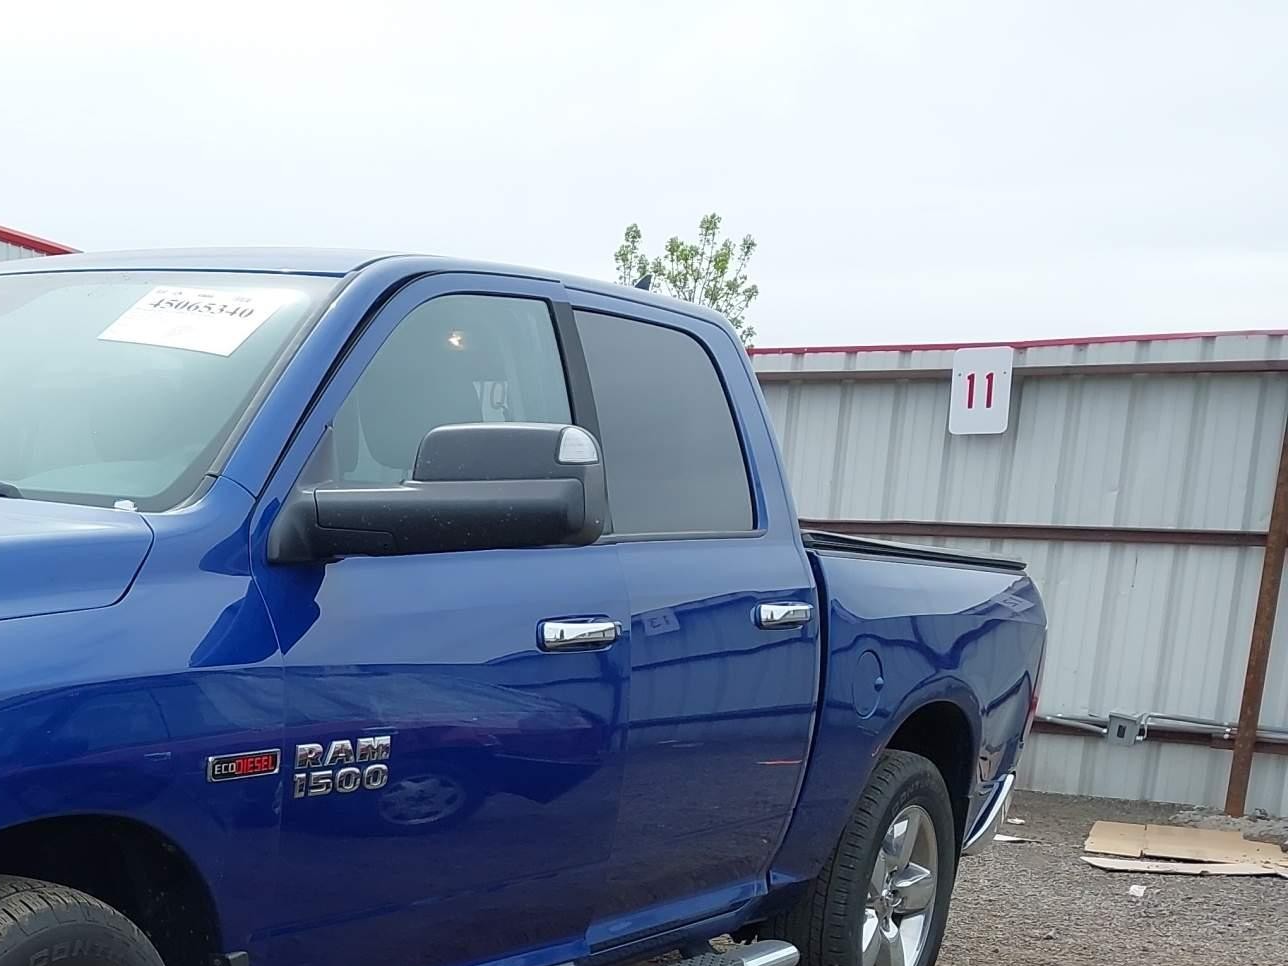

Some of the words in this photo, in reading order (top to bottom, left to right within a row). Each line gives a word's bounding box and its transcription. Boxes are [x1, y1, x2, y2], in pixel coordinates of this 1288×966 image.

[148, 297, 255, 319] 45065340
[967, 372, 994, 409] 11
[295, 736, 392, 770] RAM
[293, 764, 389, 799] 1500
